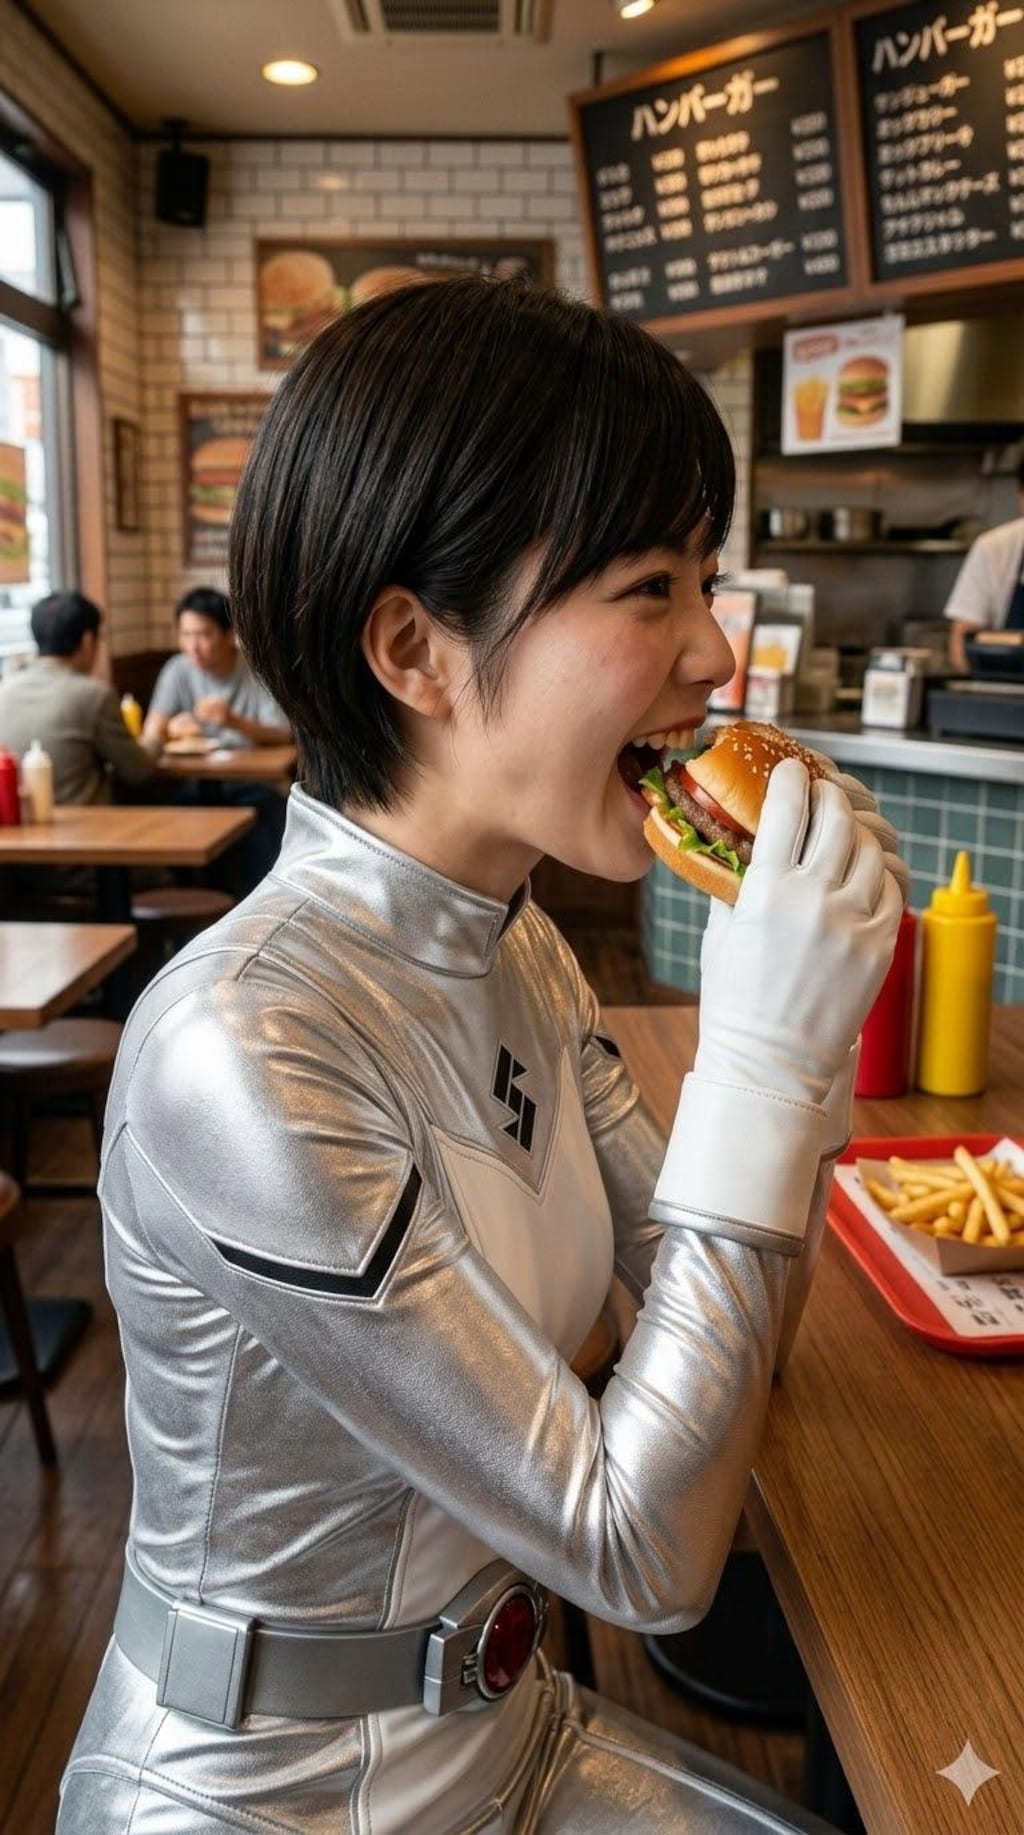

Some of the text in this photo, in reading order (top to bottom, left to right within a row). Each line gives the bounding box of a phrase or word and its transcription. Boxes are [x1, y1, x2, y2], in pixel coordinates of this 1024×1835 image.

[872, 0, 1024, 74] ハンバーガー
[631, 69, 779, 141] ハンバーガー
